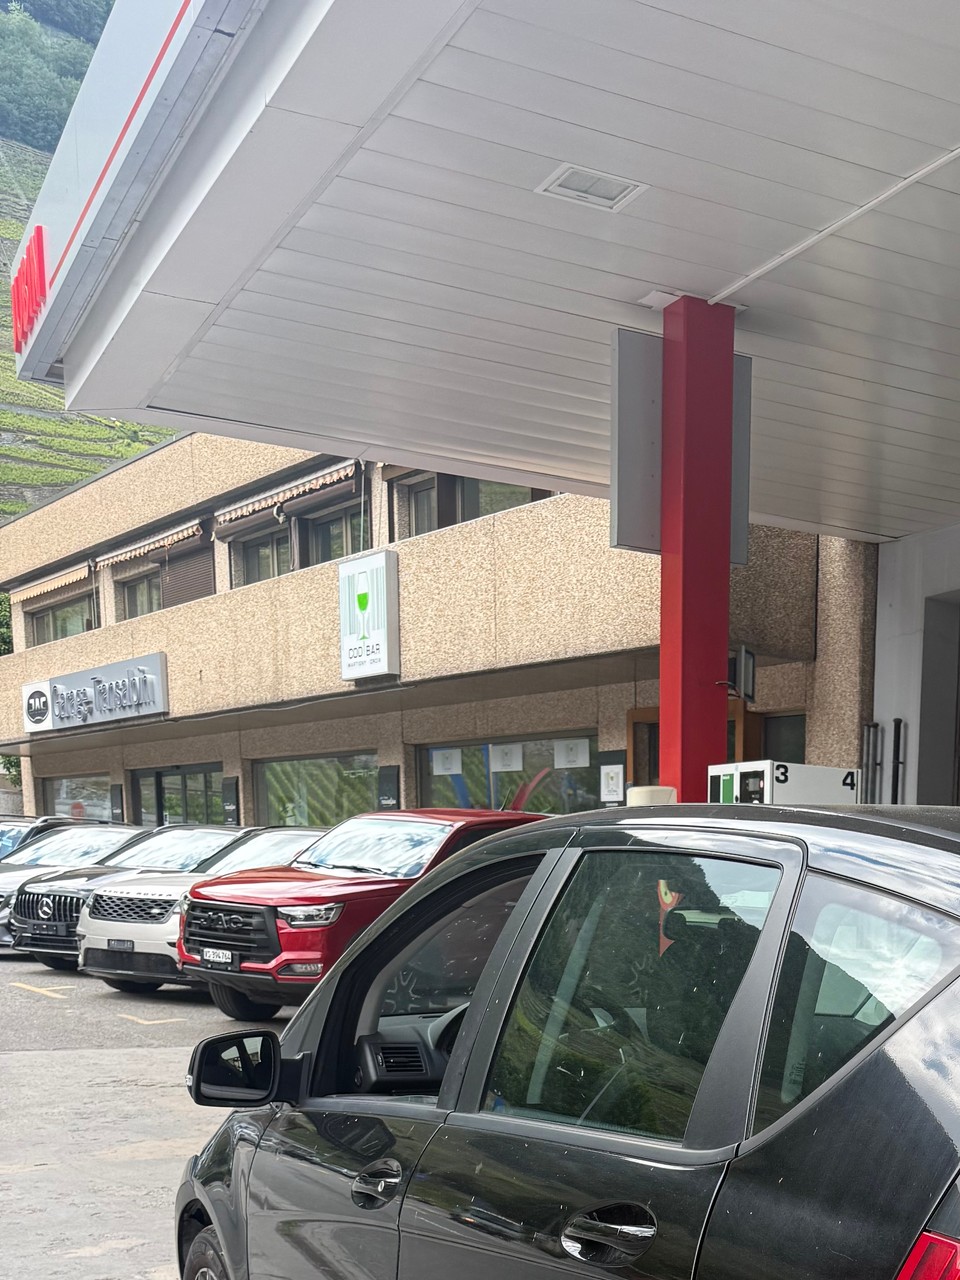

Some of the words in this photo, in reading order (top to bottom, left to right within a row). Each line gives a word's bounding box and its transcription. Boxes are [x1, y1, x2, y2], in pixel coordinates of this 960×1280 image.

[52, 685, 93, 721] Garage
[774, 764, 789, 784] 3
[841, 771, 856, 791] 4
[200, 911, 243, 929] JAC
